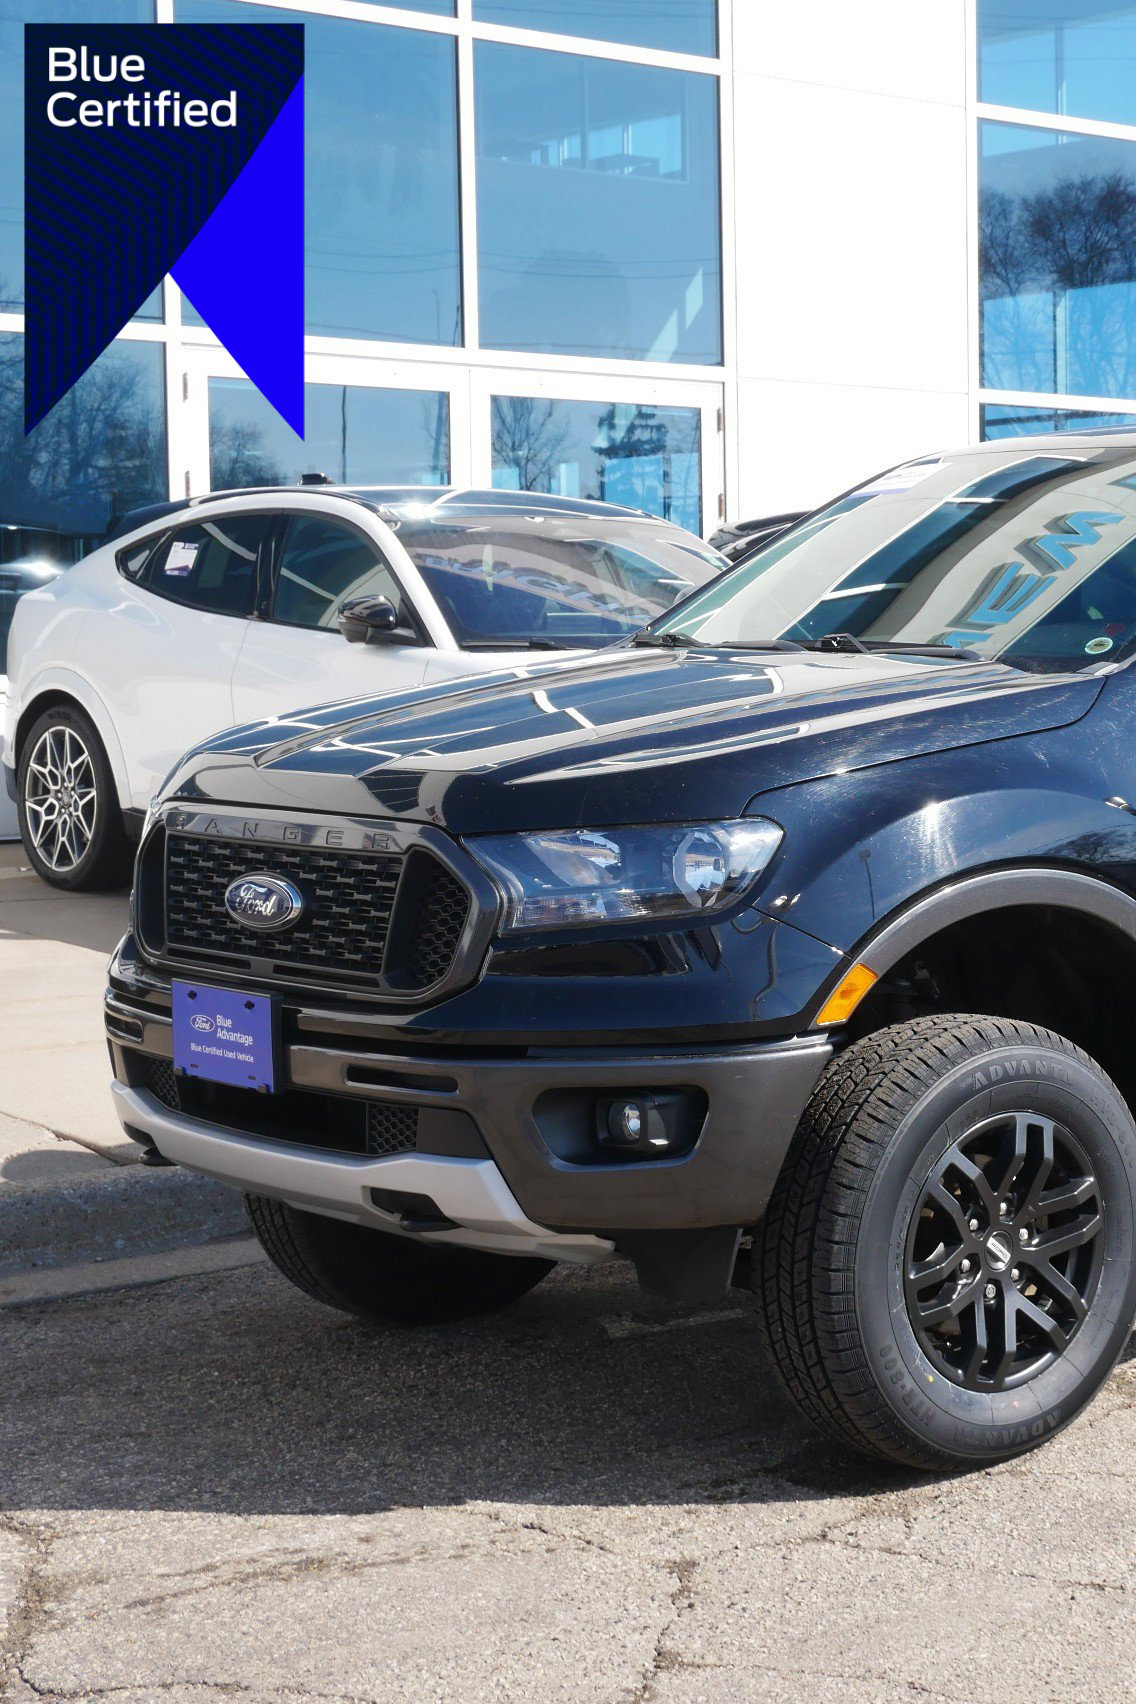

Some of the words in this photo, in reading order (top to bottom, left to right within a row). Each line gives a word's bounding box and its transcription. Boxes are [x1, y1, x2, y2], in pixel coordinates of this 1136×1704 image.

[174, 813, 393, 850] RANGER
[216, 1014, 232, 1028] Blue
[216, 1027, 253, 1046] Advantage
[190, 1042, 202, 1052] Blue
[202, 1045, 223, 1056] Certified
[223, 1049, 236, 1059] Used
[236, 1051, 254, 1063] Vehicle
[973, 1060, 1074, 1091] ADVANTA
[991, 1242, 1008, 1259] FORD
